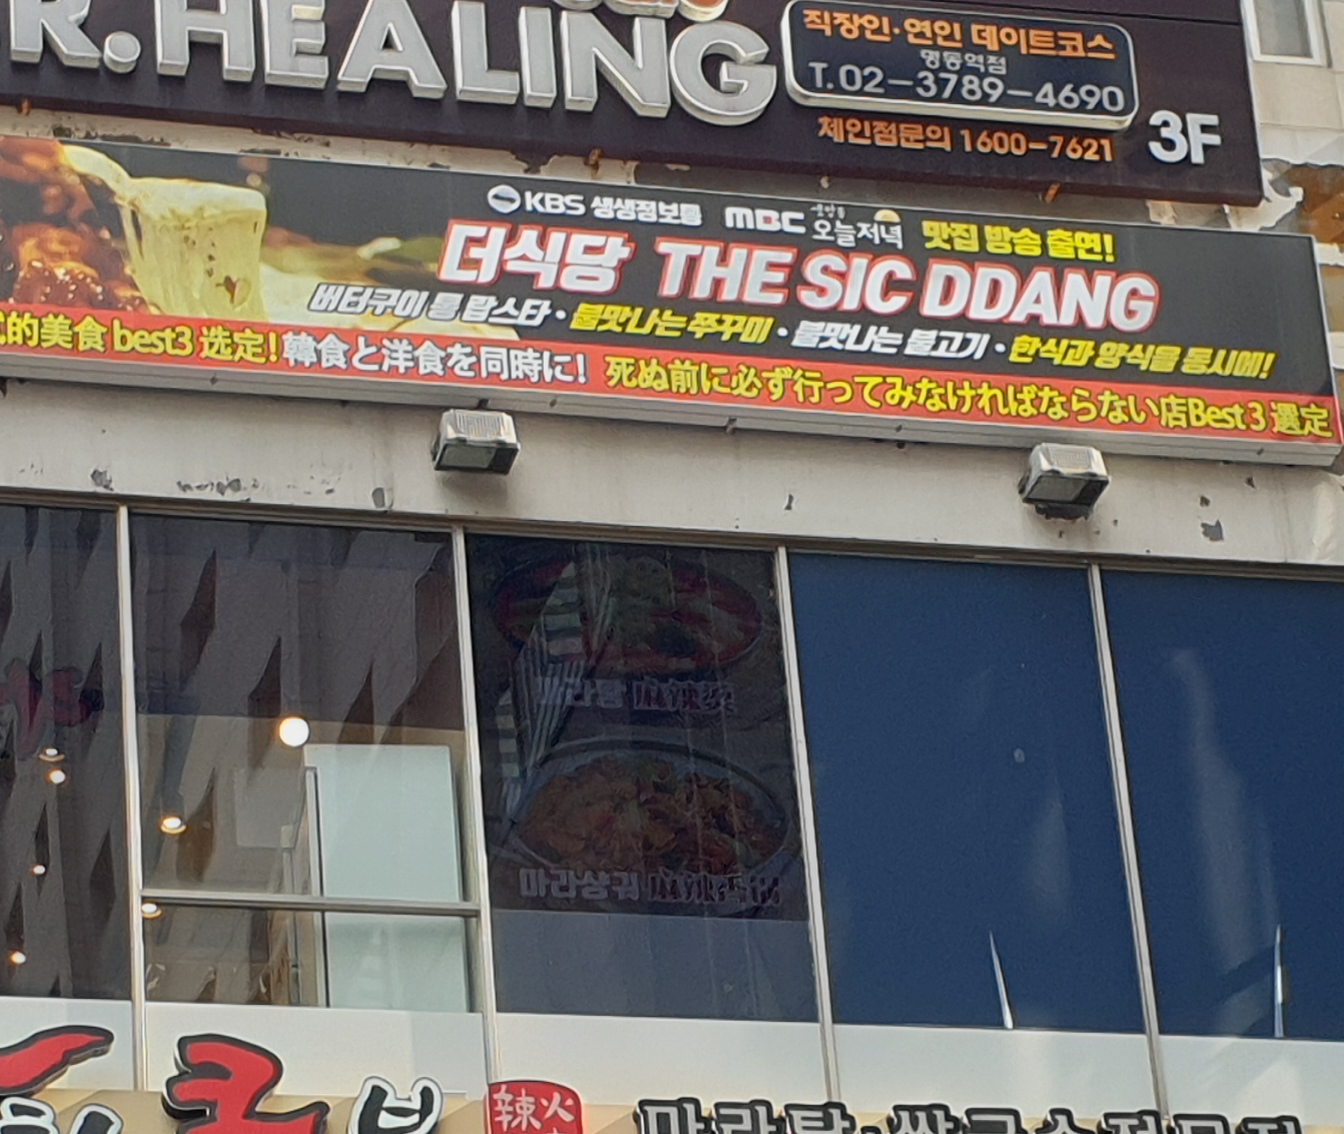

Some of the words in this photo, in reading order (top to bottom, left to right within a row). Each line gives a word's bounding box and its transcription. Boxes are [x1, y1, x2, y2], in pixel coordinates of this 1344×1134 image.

[971, 23, 1117, 60] 데이트코스
[818, 115, 952, 152] 체인점문의
[961, 128, 1114, 162] 1600-7621
[1148, 110, 1222, 165] 3F
[524, 191, 586, 216] KBS
[724, 206, 806, 234] MBC
[811, 220, 905, 250] 오늘저녁
[921, 219, 980, 254] 맛집
[984, 223, 1043, 257] 방송
[1047, 226, 1115, 262] 출연!
[436, 218, 637, 294] 더식당
[654, 236, 798, 306] THE
[796, 249, 917, 315] SIC
[919, 257, 1159, 332] DDANG
[308, 282, 430, 319] 버터구이
[907, 329, 990, 361] 불고기
[1008, 335, 1093, 368] 한식과
